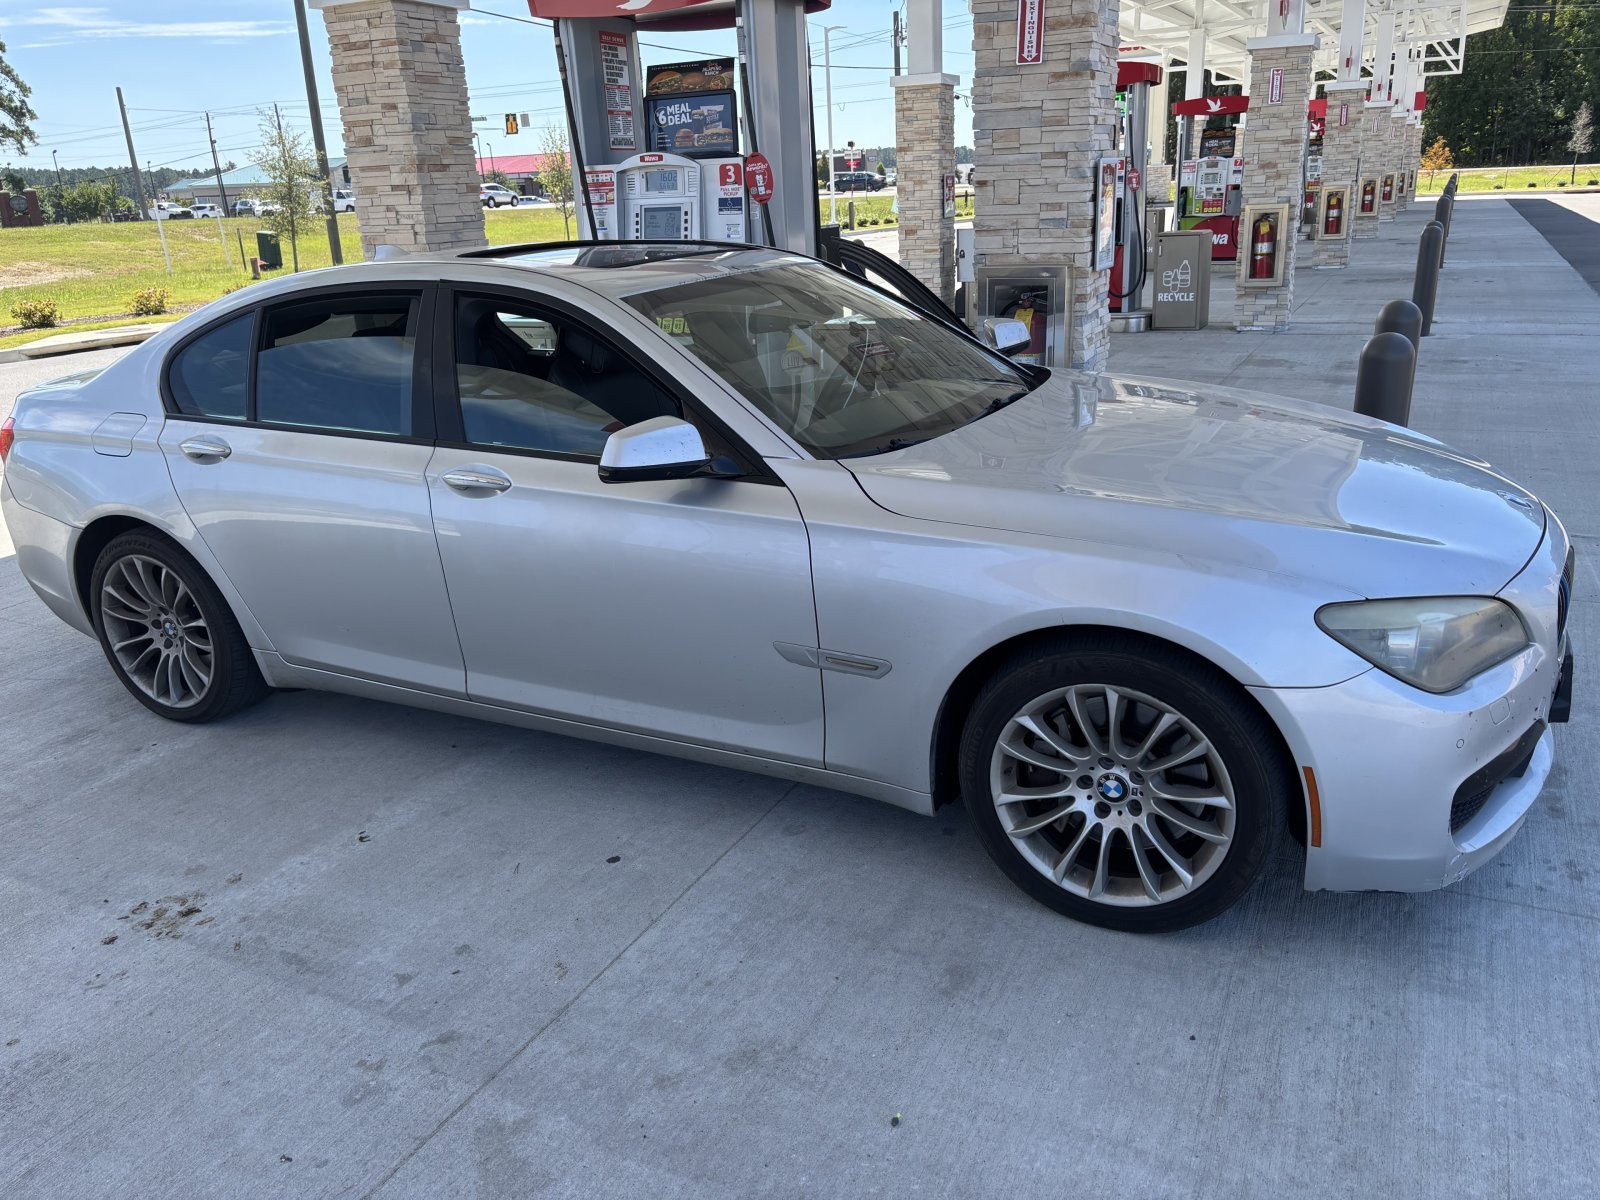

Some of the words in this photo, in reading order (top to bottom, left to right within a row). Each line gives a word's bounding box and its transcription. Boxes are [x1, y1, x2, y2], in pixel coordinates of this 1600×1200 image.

[1027, 1, 1036, 59] EXTINGUISHER
[666, 102, 692, 116] MEAL
[668, 112, 693, 126] DEAL
[725, 165, 736, 183] 3
[1157, 292, 1195, 302] RECYCLE
